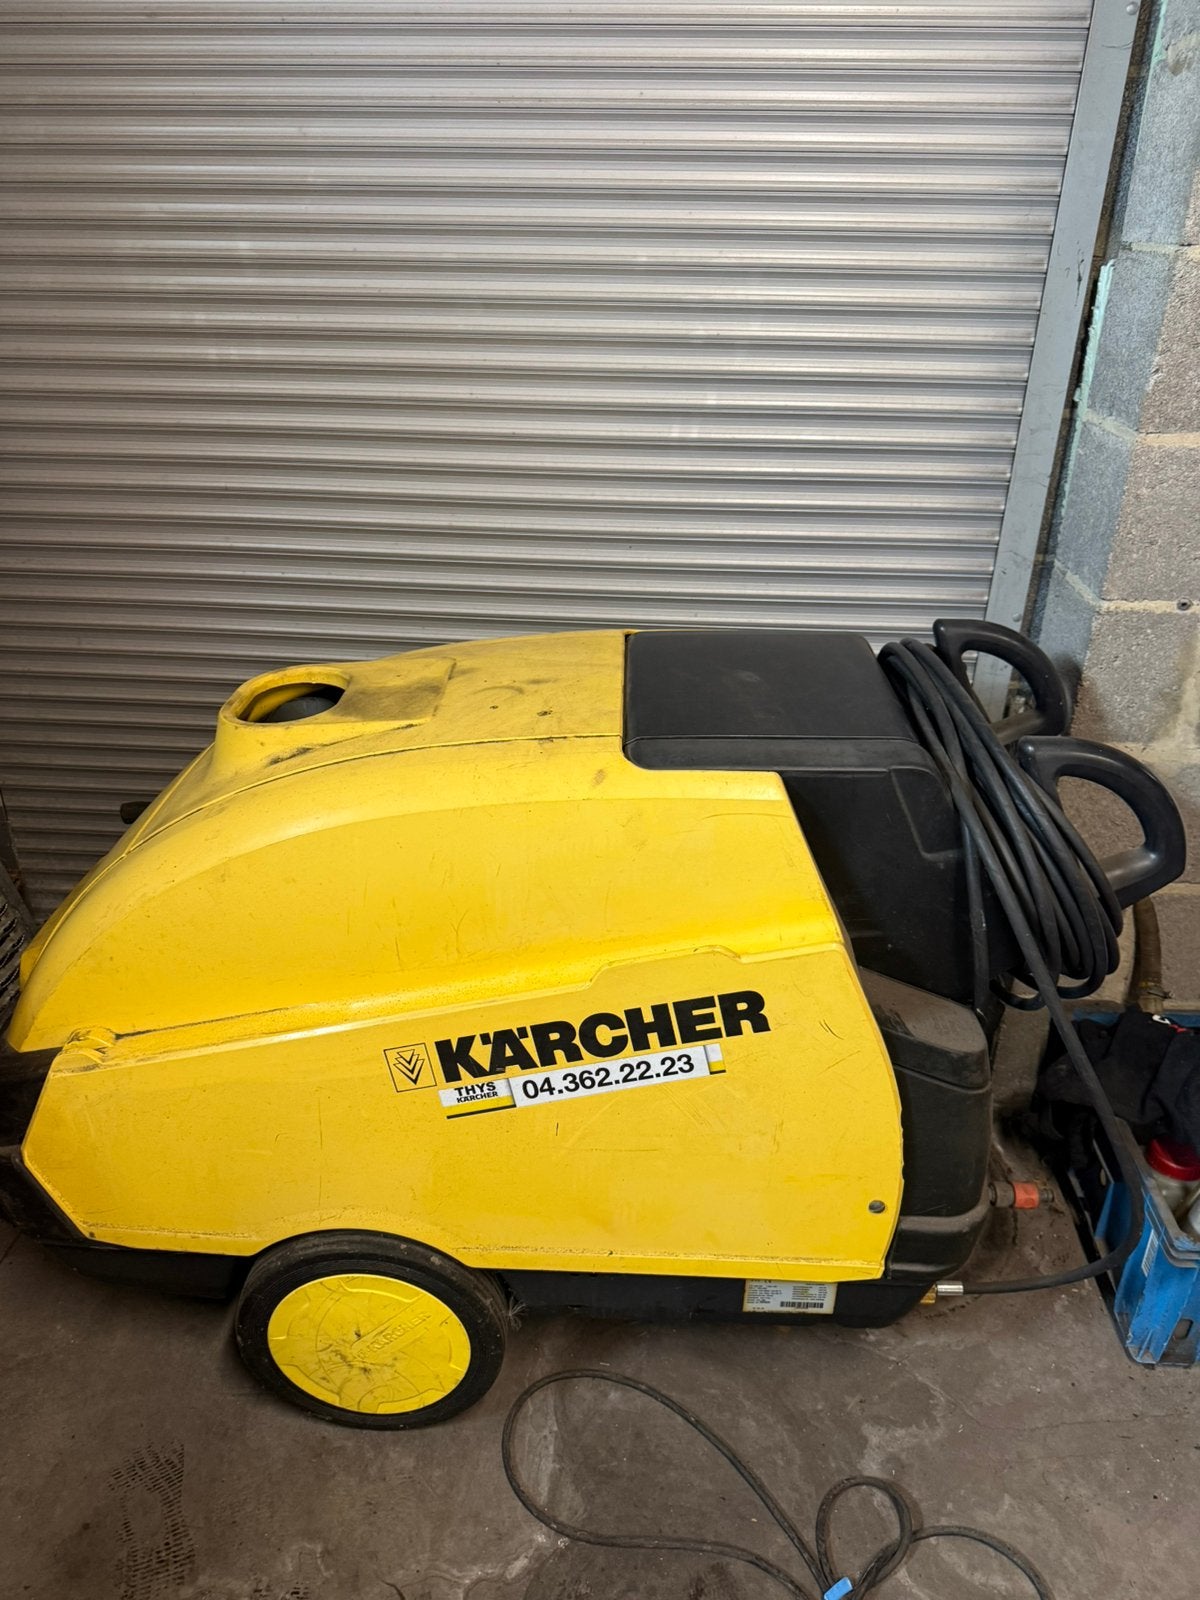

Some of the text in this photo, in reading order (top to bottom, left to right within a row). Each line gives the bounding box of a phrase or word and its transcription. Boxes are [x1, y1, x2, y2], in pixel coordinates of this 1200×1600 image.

[435, 990, 770, 1083] KÄRCHER
[454, 1081, 496, 1097] THYS
[522, 1053, 695, 1100] 04.362.22.23
[457, 1091, 499, 1104] KÄRCHER
